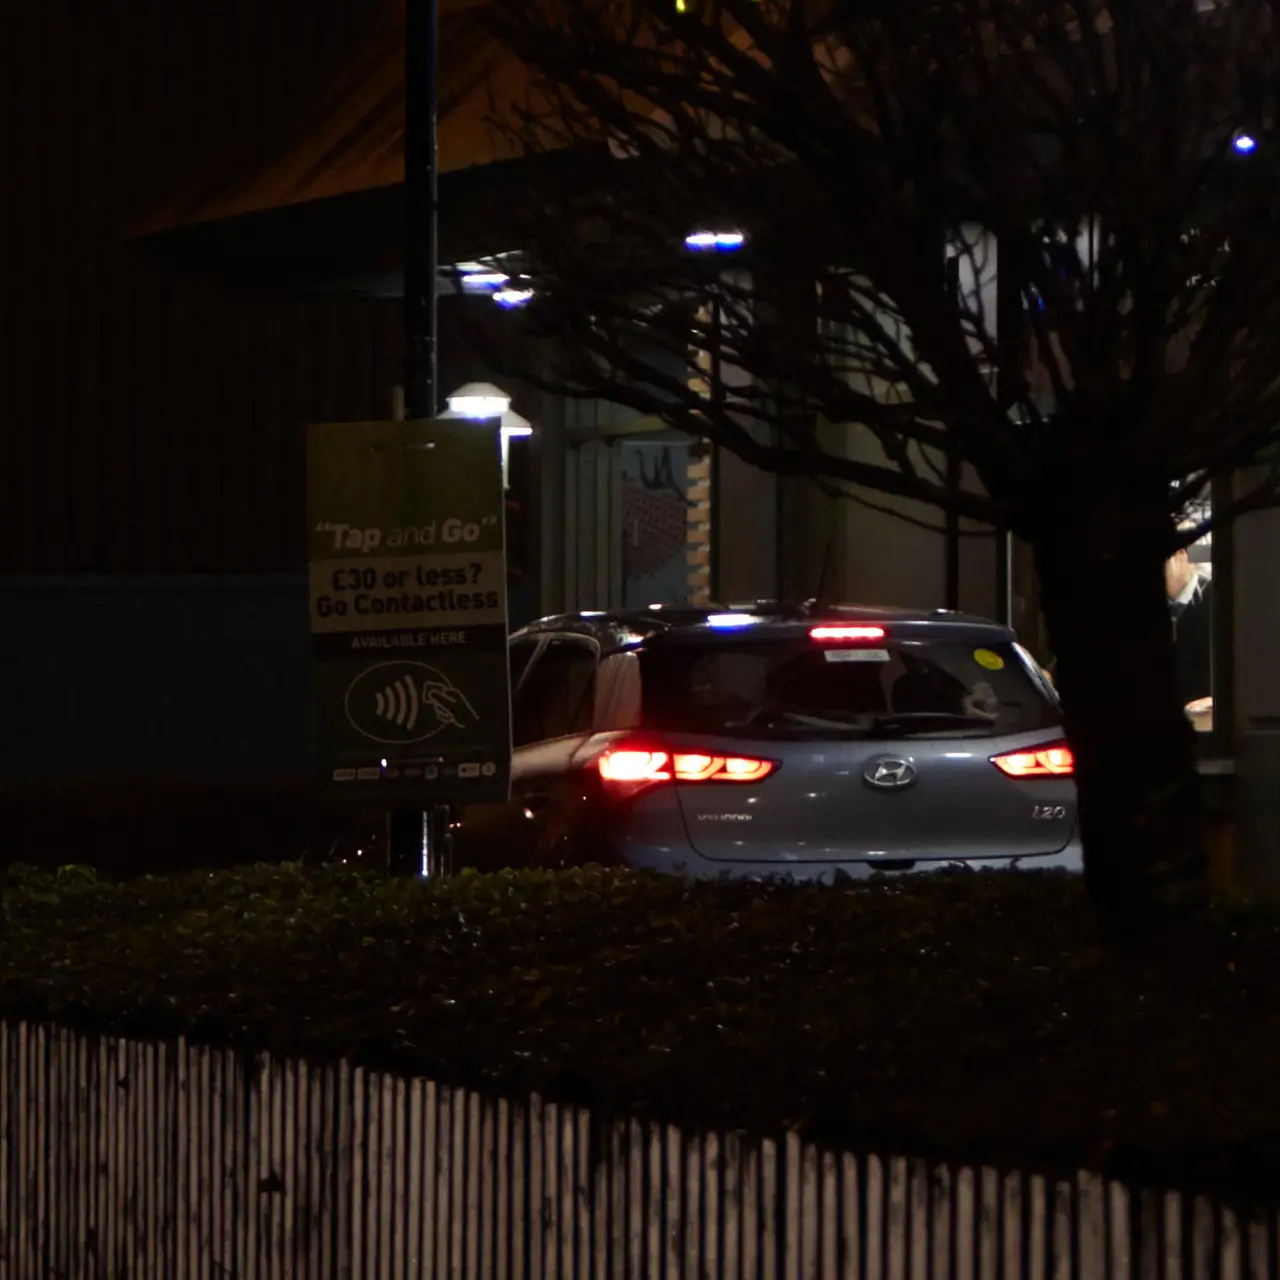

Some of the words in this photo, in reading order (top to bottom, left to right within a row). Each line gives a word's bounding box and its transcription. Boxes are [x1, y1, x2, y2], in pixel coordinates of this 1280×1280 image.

[386, 518, 437, 547] and
[332, 567, 377, 591] £30
[383, 570, 411, 589] or
[416, 563, 483, 587] less?
[316, 595, 348, 618] Go
[354, 589, 499, 616] Contactless
[429, 631, 469, 646] HERE
